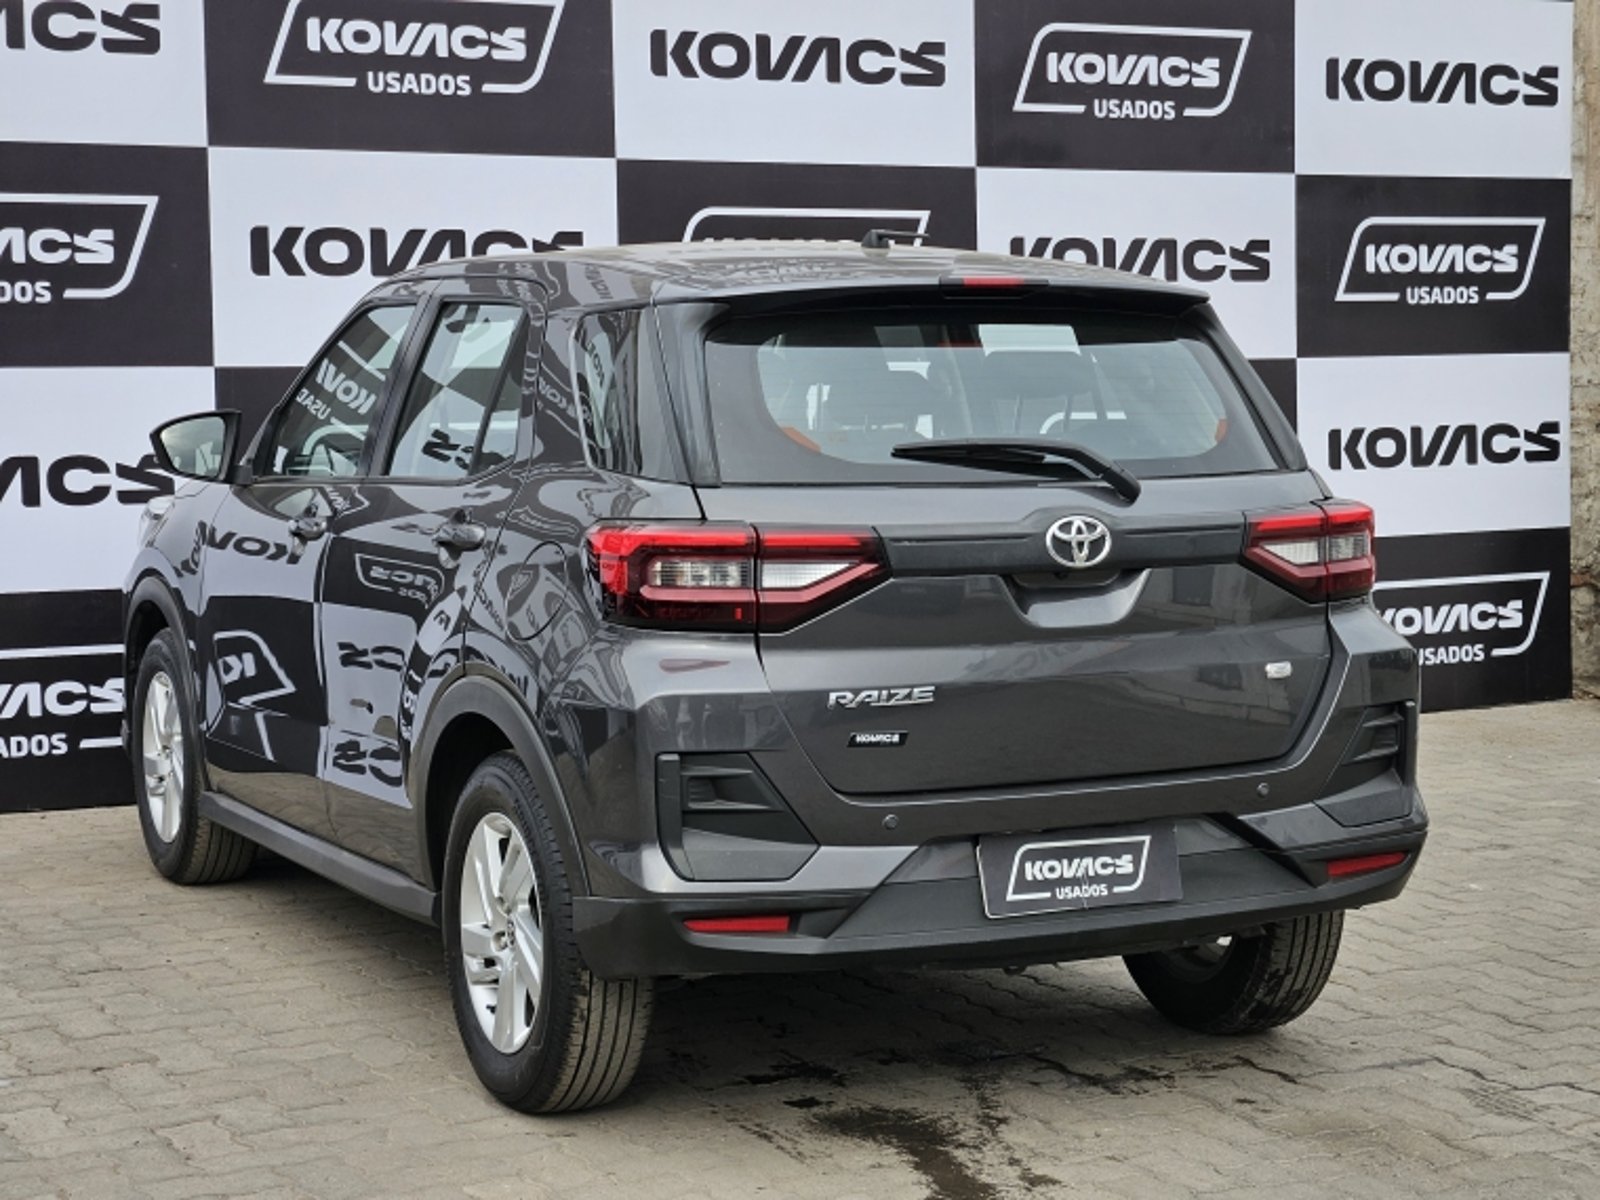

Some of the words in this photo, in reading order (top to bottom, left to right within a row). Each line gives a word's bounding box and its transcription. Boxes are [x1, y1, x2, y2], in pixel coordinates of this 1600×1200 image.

[306, 17, 527, 62] KOVACS
[649, 28, 946, 88] KOVACS
[1046, 51, 1221, 89] KOVACS
[366, 70, 472, 97] USADOS
[1326, 56, 1559, 107] KOVACS
[1093, 98, 1176, 121] USADOS
[1365, 243, 1519, 274] KOVACS
[1406, 286, 1480, 305] USADOS
[1327, 420, 1561, 470] KOVACS
[827, 685, 936, 709] RAIZE
[1024, 854, 1134, 881] KOVACS
[1055, 884, 1109, 900] USADOS
